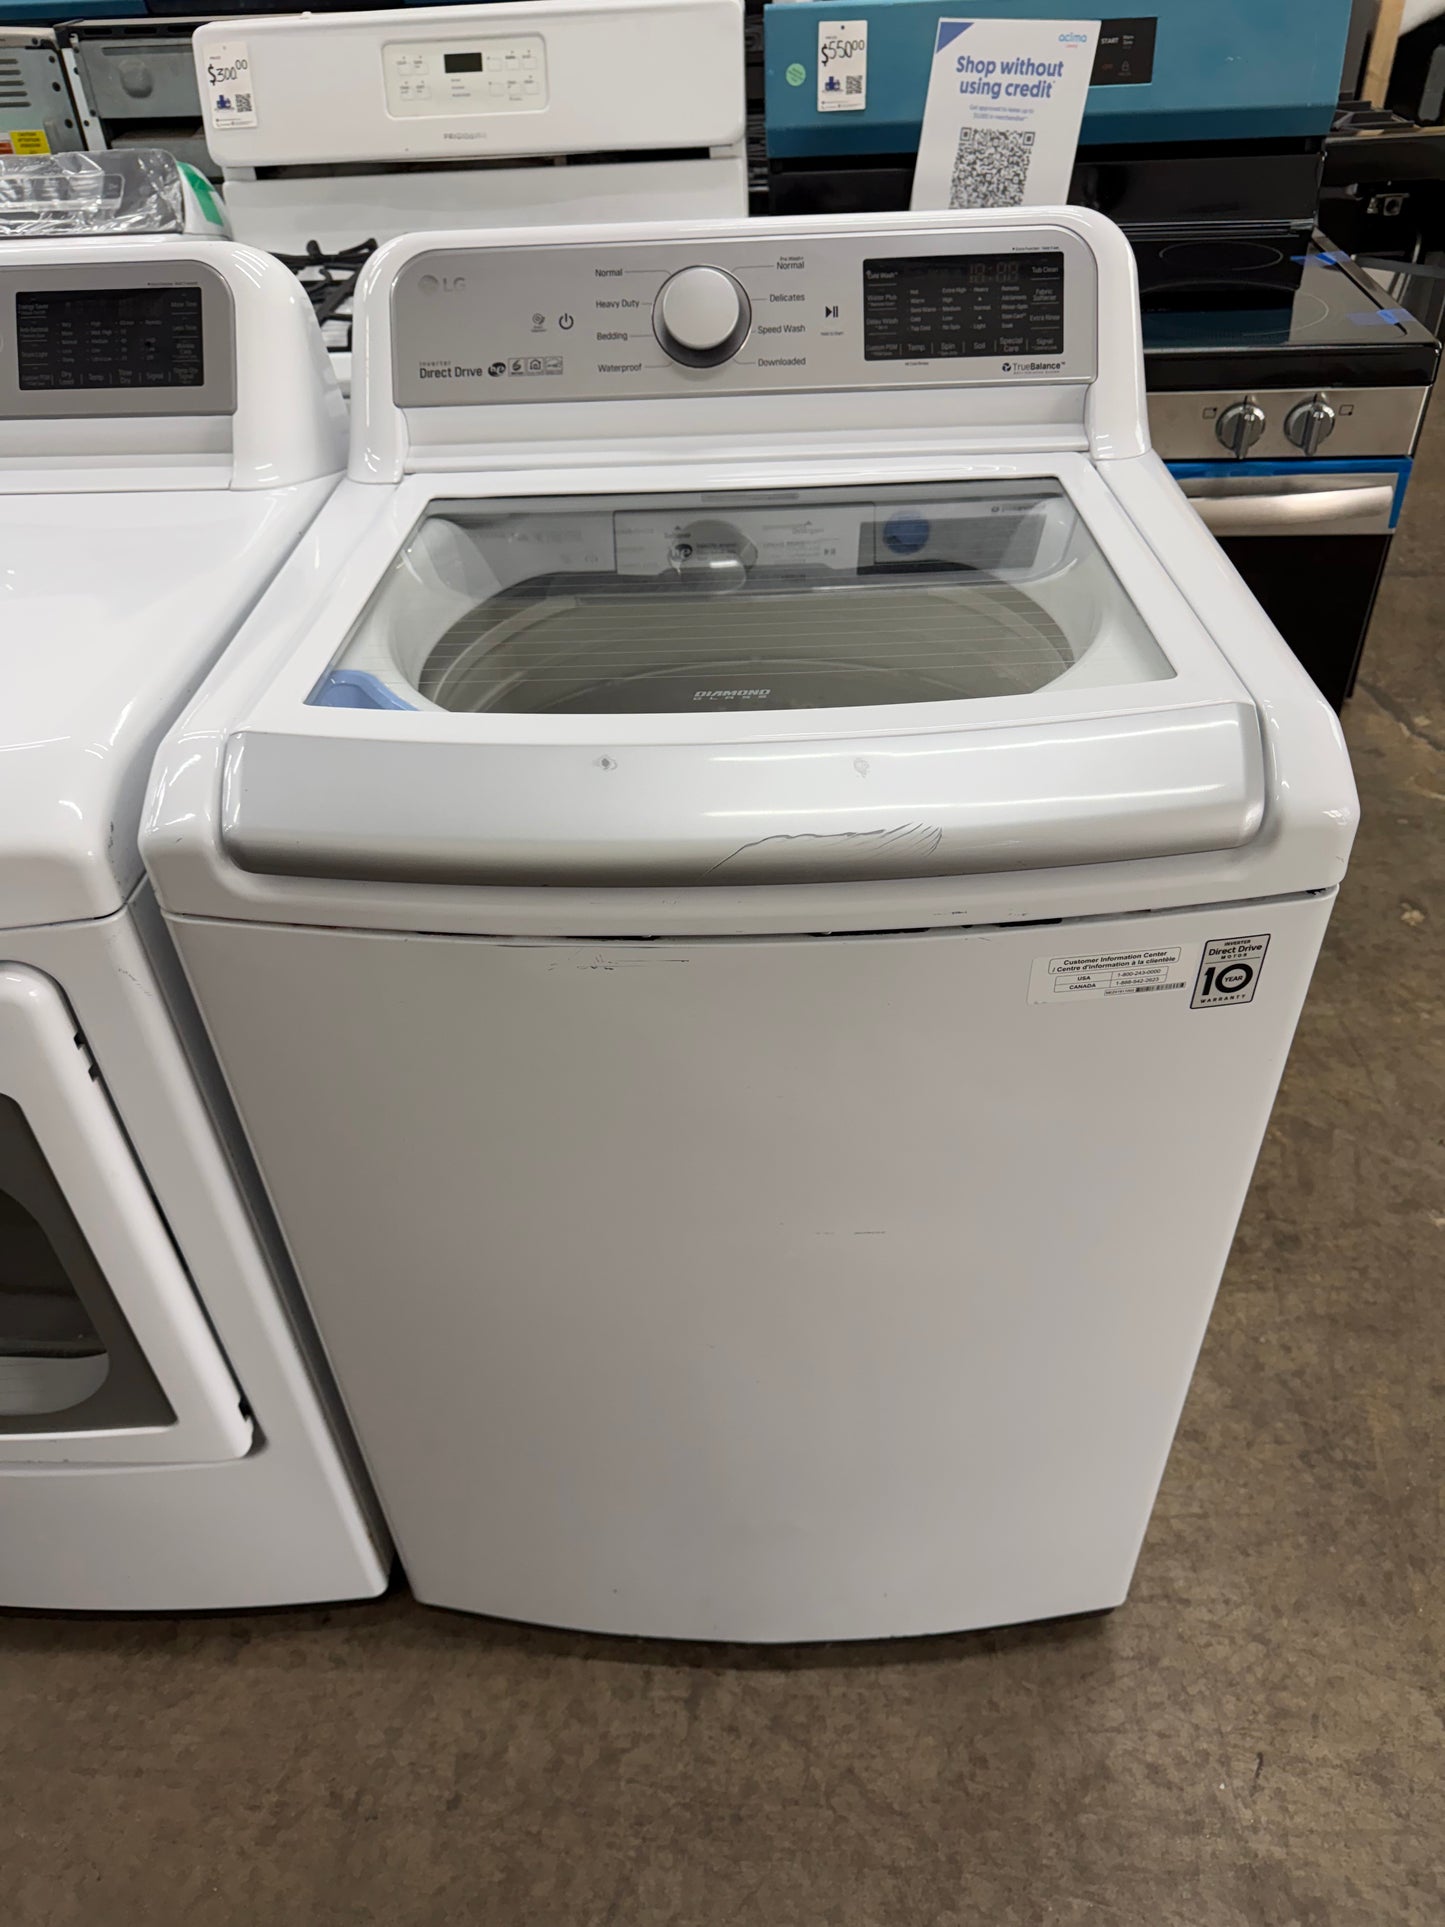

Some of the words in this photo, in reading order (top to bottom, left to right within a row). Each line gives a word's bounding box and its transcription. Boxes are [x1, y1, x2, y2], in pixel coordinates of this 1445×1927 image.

[1058, 32, 1088, 43] acima
[1100, 37, 1120, 45] START
[956, 56, 996, 78] Shop
[1000, 57, 1064, 77] without
[959, 77, 1001, 99] using
[776, 261, 805, 270] Normal
[595, 268, 623, 278] Normal
[442, 277, 467, 292] LG
[596, 300, 620, 309] Heavy
[621, 298, 640, 308] Duty
[769, 293, 805, 303] Delicates
[757, 325, 782, 335] Speed
[783, 324, 806, 333] Wash
[597, 332, 628, 342] Bedding
[757, 356, 806, 367] Downloaded
[419, 367, 452, 379] Direct
[454, 366, 483, 378] Drive
[597, 362, 642, 373] Waterproof
[694, 689, 771, 697] DIAMOND
[1208, 946, 1237, 956] Direct
[1238, 944, 1263, 953] Drive
[1063, 957, 1099, 965] Customer
[1100, 953, 1142, 963] Information
[1143, 950, 1168, 958] Center
[1056, 965, 1081, 973] Centre
[1082, 960, 1130, 970] d'information
[1137, 958, 1144, 966] la
[1145, 956, 1176, 965] clientèle
[1202, 963, 1253, 996] 10
[1224, 975, 1243, 983] YEAR
[1200, 994, 1246, 1004] WARRANTY
